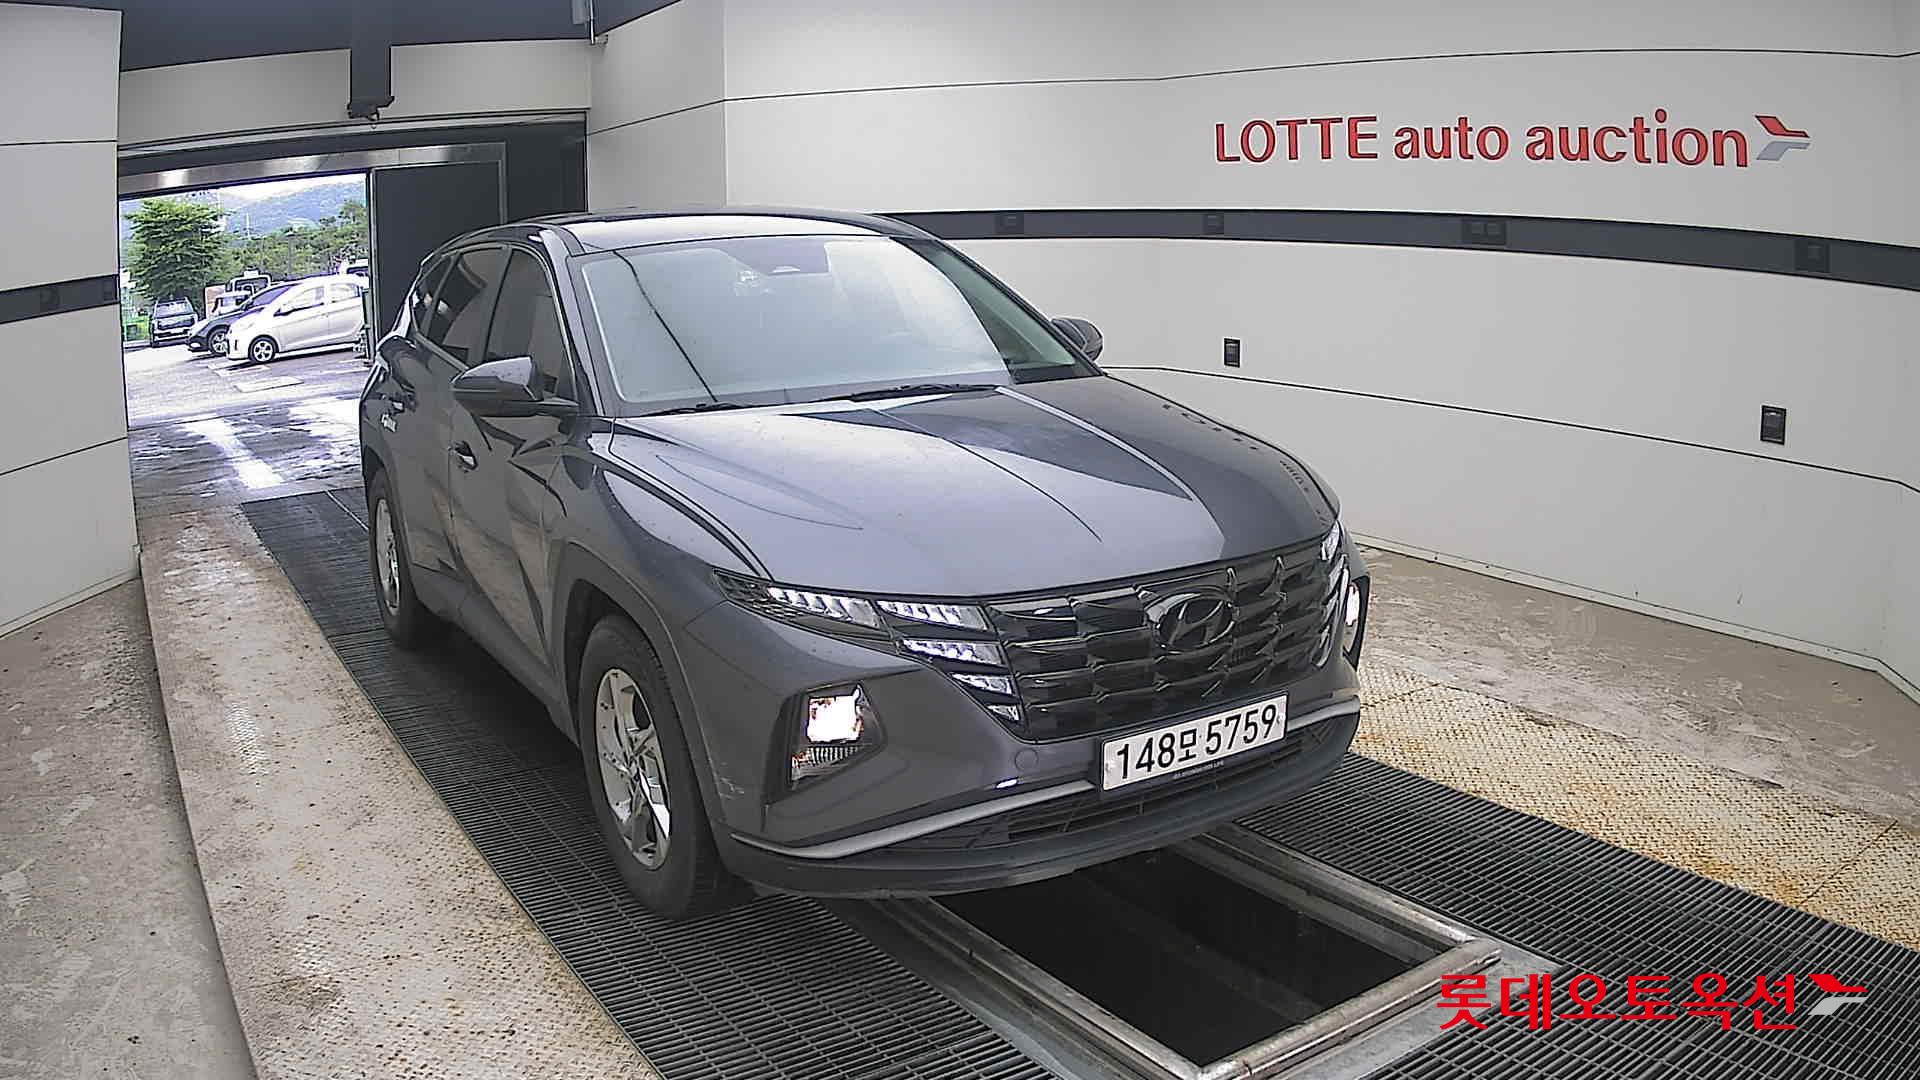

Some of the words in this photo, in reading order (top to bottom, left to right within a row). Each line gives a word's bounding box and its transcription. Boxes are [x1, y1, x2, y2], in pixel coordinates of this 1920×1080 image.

[1216, 116, 1378, 162] LOTTE
[1394, 117, 1509, 160] auto
[1525, 109, 1748, 168] auction
